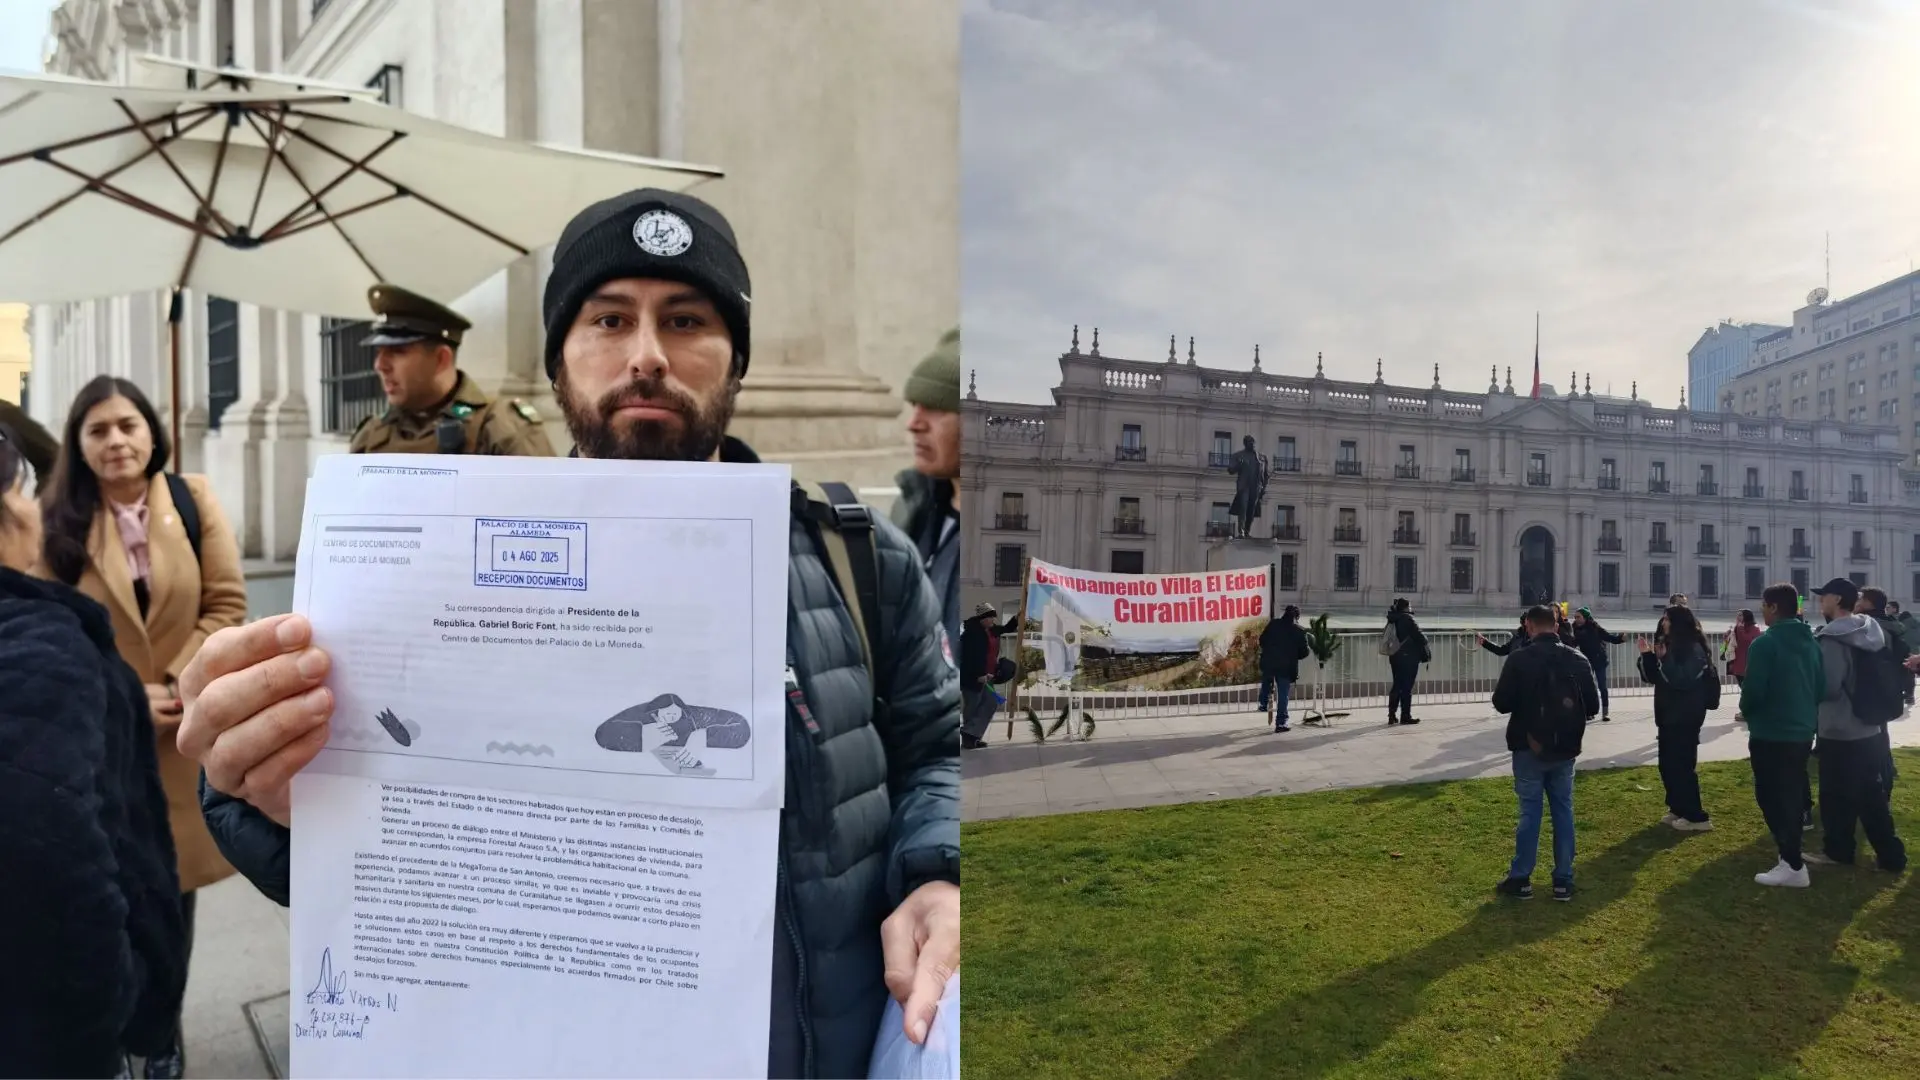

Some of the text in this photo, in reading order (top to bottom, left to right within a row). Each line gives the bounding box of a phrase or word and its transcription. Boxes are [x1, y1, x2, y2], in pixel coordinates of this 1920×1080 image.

[481, 520, 516, 528] PALACIO
[323, 539, 421, 549] CENTRO DE DOCUMENTACIÓN
[329, 555, 411, 565] PALACIO DE LA MONEDA
[519, 551, 537, 562] AGO
[540, 551, 559, 563] 2025
[478, 573, 584, 587] RECEPCION DOCUMENTOS
[1036, 567, 1266, 596] Campamento Villa El Eden
[445, 604, 456, 612] Su
[457, 605, 523, 615] correspondencia
[525, 606, 555, 615] dirigida
[567, 607, 615, 617] Presidente
[618, 609, 629, 617] de
[631, 609, 640, 617] la
[1114, 595, 1262, 624] Curanilahue
[479, 620, 509, 629] Gabriel
[511, 620, 534, 629] Boric
[536, 621, 558, 631] Font,
[560, 623, 570, 631] ha
[573, 623, 590, 632] sido
[593, 624, 626, 633] recibida
[628, 626, 642, 634] por
[645, 625, 653, 634] el
[441, 634, 468, 643] Centro
[470, 635, 480, 643] de
[482, 635, 533, 645] Documentos
[535, 637, 547, 645] del
[550, 637, 579, 647] Palacio
[582, 639, 592, 647] de
[595, 639, 605, 648] La
[381, 783, 392, 791] Ver
[394, 785, 438, 796] posibilidades
[440, 789, 448, 797] de
[450, 793, 475, 802] compra
[477, 794, 485, 802] de
[487, 795, 497, 803] los
[499, 798, 527, 807] sectores
[529, 800, 564, 811] habitados
[566, 806, 579, 814] que
[580, 806, 594, 816] hoy
[596, 808, 615, 817] están
[628, 813, 657, 821] proceso
[659, 814, 668, 822] de
[670, 815, 703, 827] desalojo,
[382, 815, 408, 825] Generar
[422, 821, 449, 829] proceso
[452, 823, 460, 831] de
[463, 824, 488, 835] diálogo
[491, 828, 509, 836] entre
[520, 831, 556, 841] Ministerio
[566, 836, 575, 844] las
[577, 837, 607, 847] distintas
[610, 841, 646, 852] instancias
[649, 845, 703, 858] institucionales
[397, 829, 445, 841] correspondan,
[457, 836, 486, 844] empresa
[489, 837, 516, 847] Forestal
[519, 841, 543, 850] Arauco
[569, 847, 578, 855] las
[581, 850, 635, 861] organizaciones
[637, 855, 646, 863] de
[650, 857, 682, 868] vivienda,
[382, 838, 407, 846] avanzar
[420, 842, 450, 851] acuerdos
[452, 846, 486, 855] conjuntos
[505, 851, 533, 860] resolver
[535, 853, 541, 861] la
[543, 856, 590, 867] problemática
[593, 860, 636, 872] habitacional
[650, 867, 656, 875] la
[354, 895, 381, 903] relación
[389, 898, 402, 906] esta
[404, 901, 439, 910] propuesta
[354, 953, 417, 968] desalojos forzosos.
[397, 937, 415, 946] tanto
[434, 942, 460, 950] nuestra
[465, 944, 508, 955] Constitución
[545, 953, 553, 961] de
[652, 966, 662, 975] los
[668, 969, 698, 979] tratados
[354, 943, 698, 990] internacionales sobre derechos humanos especialmente los acuerdos firmados por Chile sobre
[354, 970, 364, 978] Sin
[366, 972, 379, 980] más
